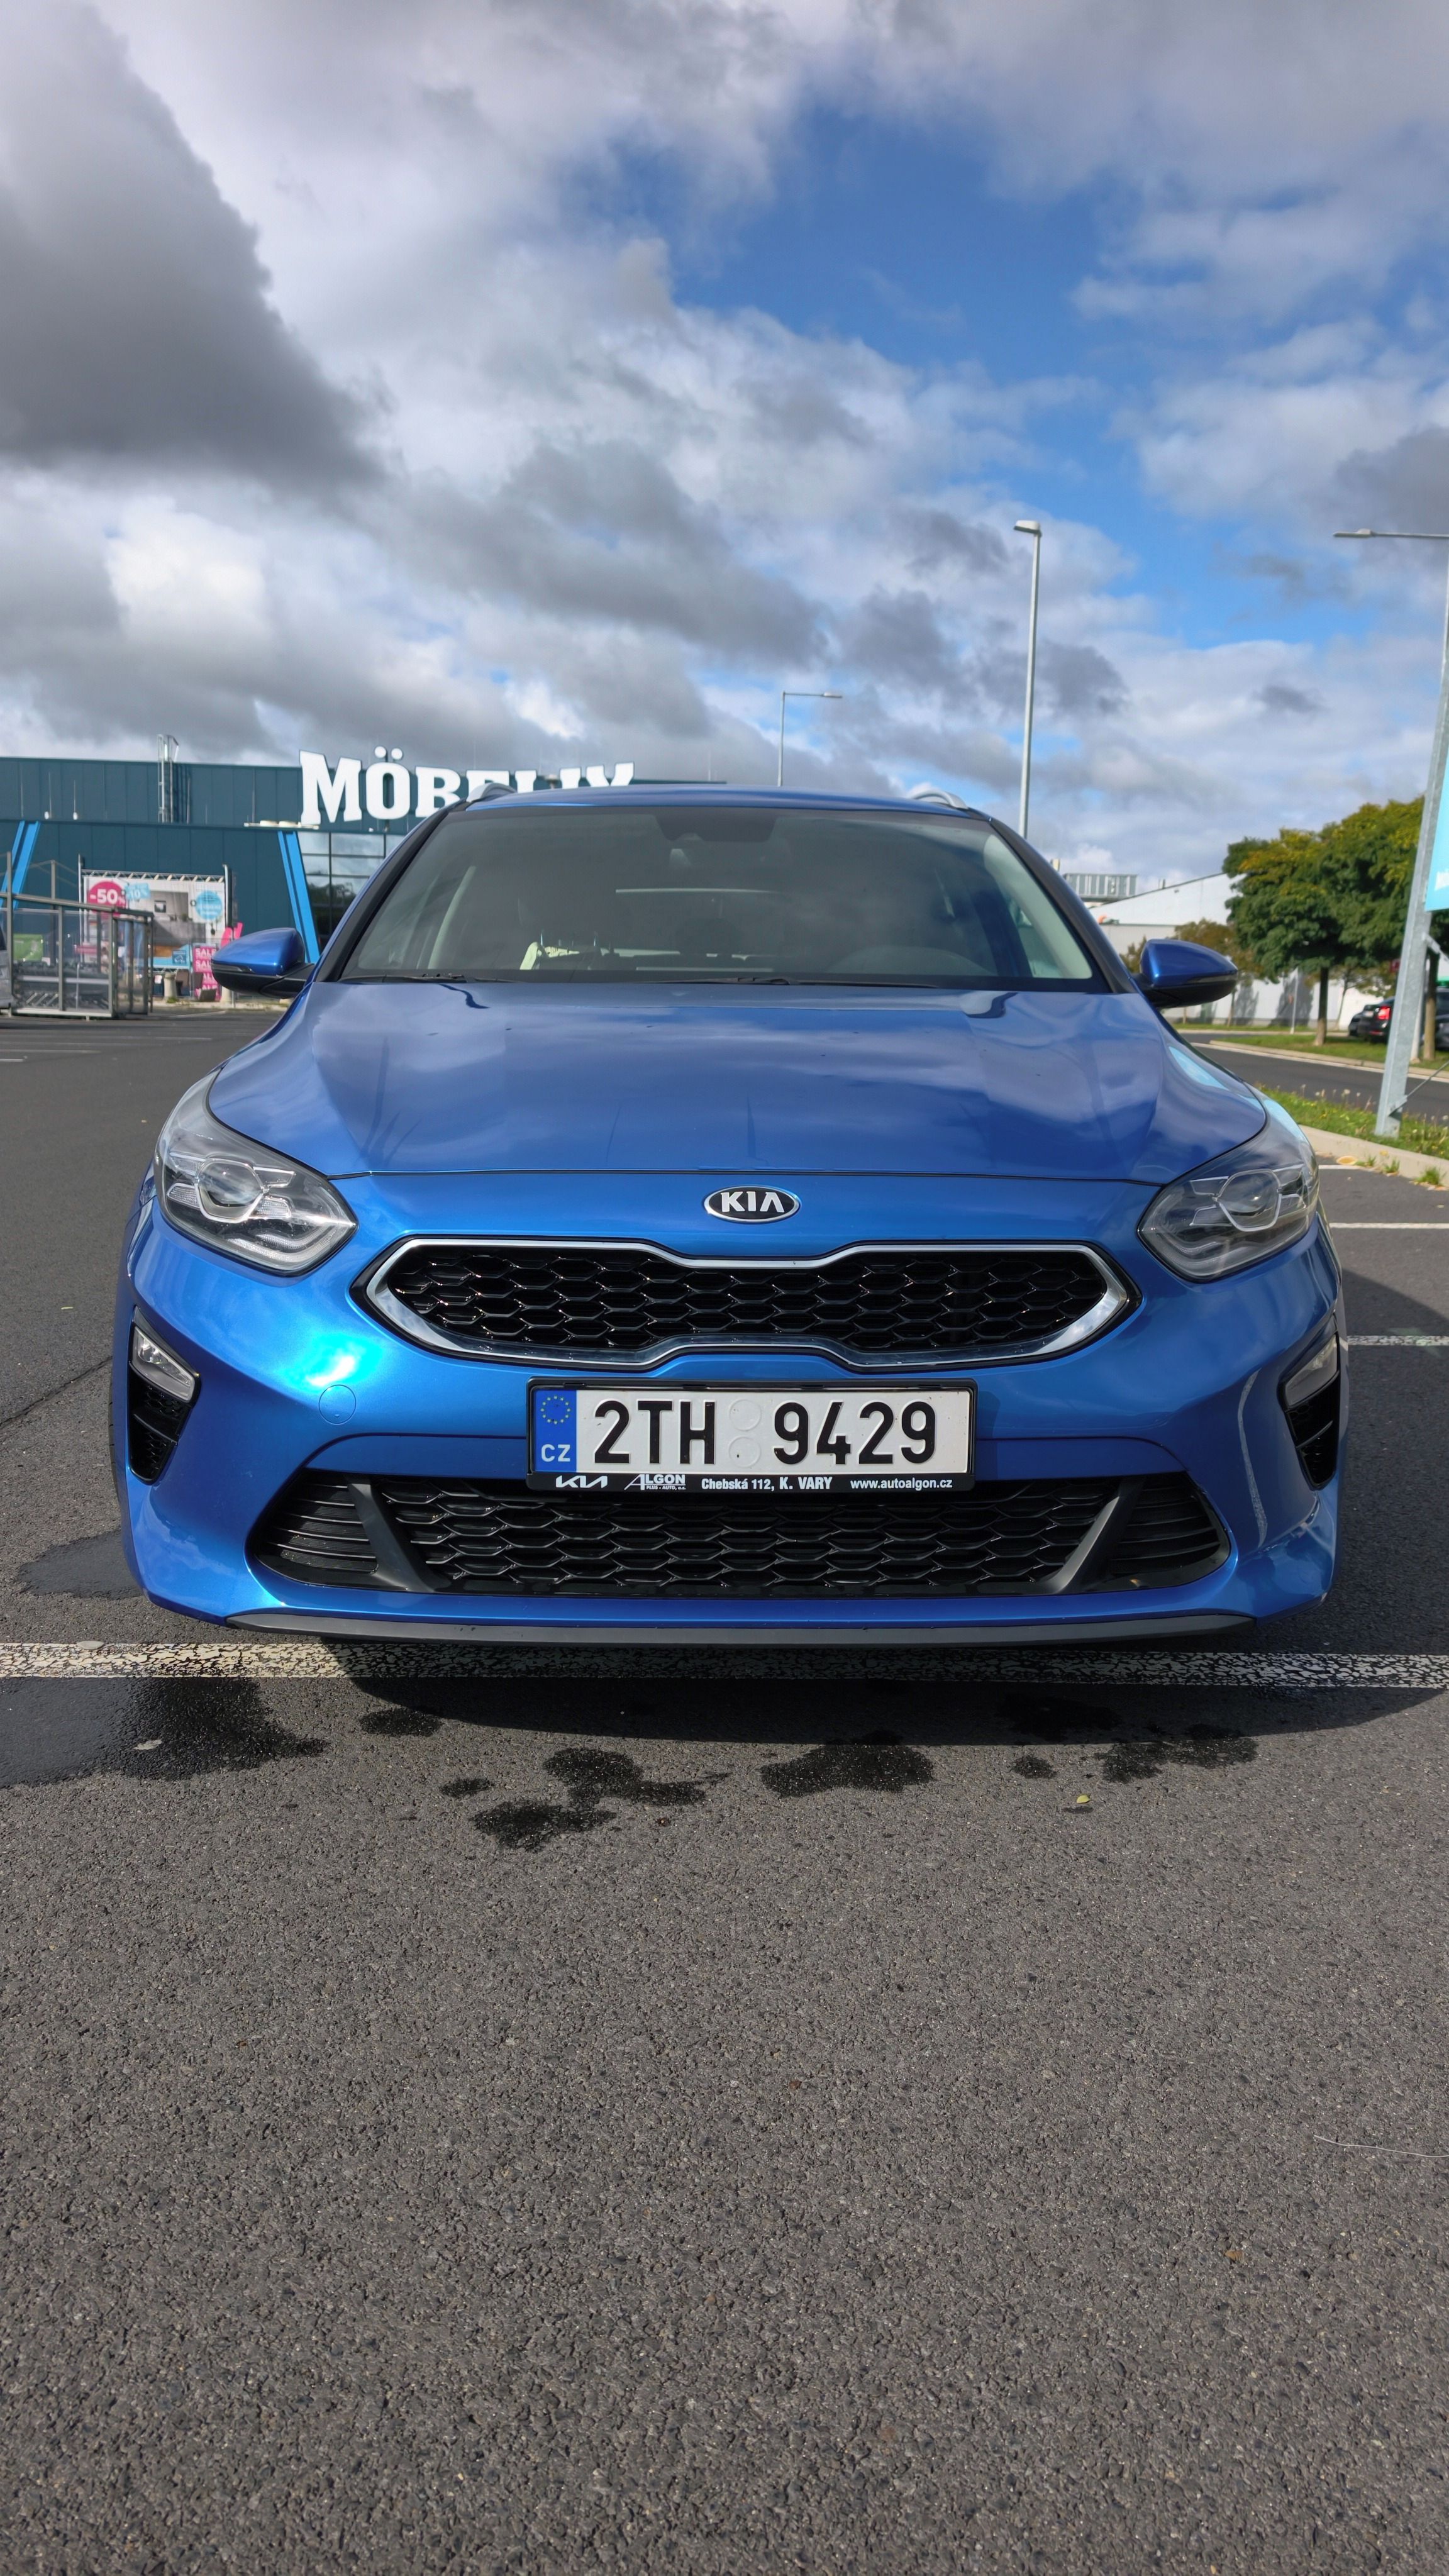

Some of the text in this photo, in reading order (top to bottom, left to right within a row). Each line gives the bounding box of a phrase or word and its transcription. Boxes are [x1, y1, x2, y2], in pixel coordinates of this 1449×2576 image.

[196, 960, 212, 968] SAL
[720, 1191, 785, 1213] KIA
[594, 1400, 936, 1465] 2TH 9429
[541, 1444, 570, 1463] CZ
[555, 1475, 608, 1489] KIA
[624, 1474, 686, 1491] ALGON
[701, 1477, 952, 1491] Chebská 112, K. VARY www.autoalgon.cz
